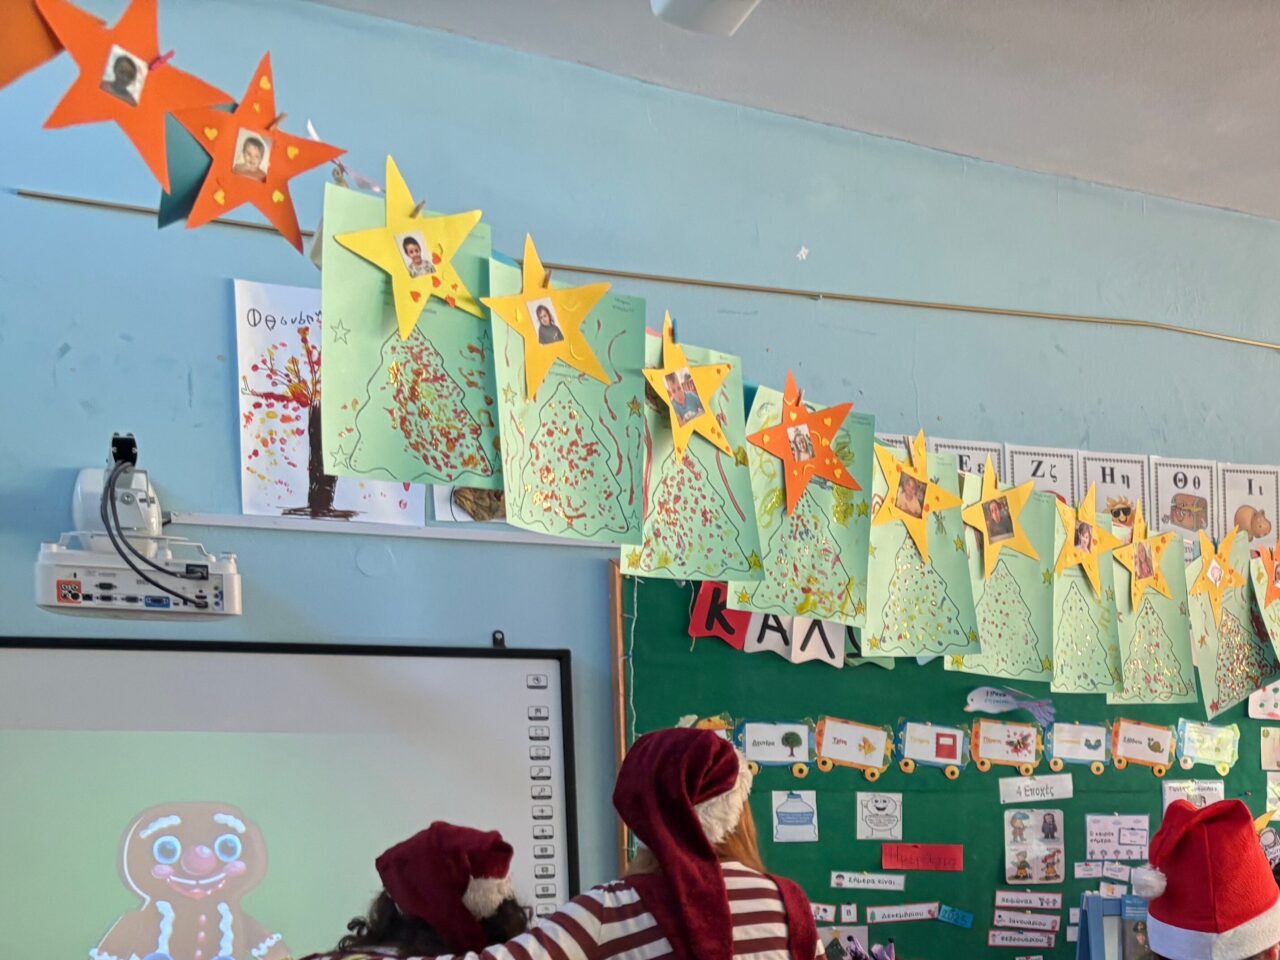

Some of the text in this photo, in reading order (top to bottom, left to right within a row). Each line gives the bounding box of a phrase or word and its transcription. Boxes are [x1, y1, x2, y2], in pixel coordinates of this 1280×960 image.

[957, 454, 972, 472] Ε
[1031, 459, 1046, 478] Ζ
[1100, 466, 1116, 485] Η
[1173, 471, 1188, 489] Θ
[1246, 478, 1255, 496] Ι
